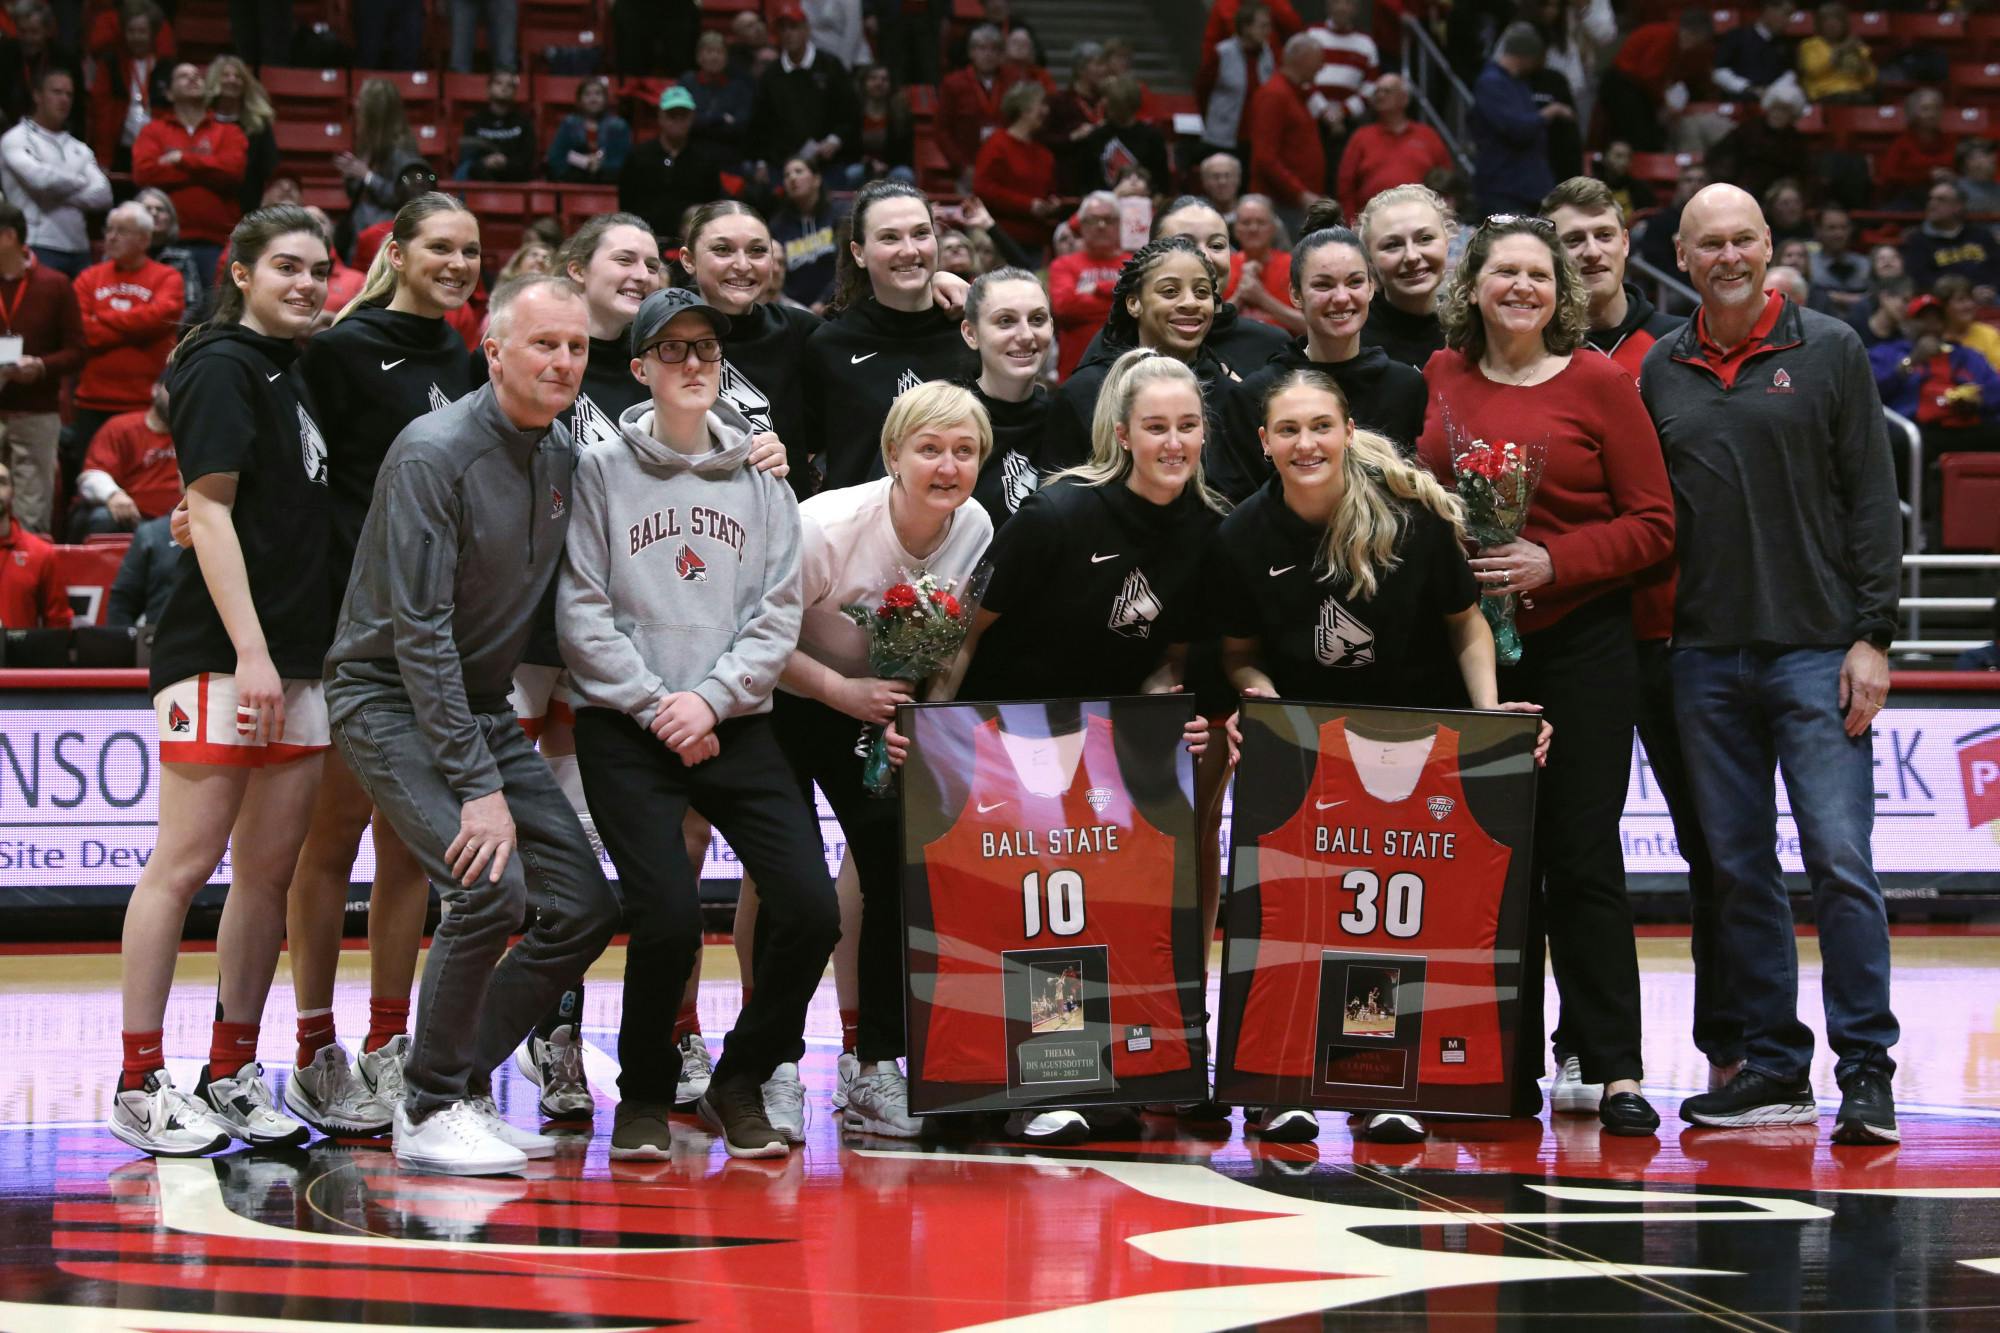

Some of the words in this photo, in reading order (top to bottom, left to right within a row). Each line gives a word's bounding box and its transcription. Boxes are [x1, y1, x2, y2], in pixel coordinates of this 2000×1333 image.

[629, 506, 682, 558] BALL
[690, 506, 747, 566] STATE
[982, 830, 1039, 858] BALL
[1049, 824, 1119, 855] STATE
[1315, 825, 1373, 854] BALL
[1383, 829, 1457, 859] STATE
[1022, 869, 1087, 939] 10
[1339, 868, 1425, 939] 30
[1133, 1027, 1143, 1037] M
[1448, 1040, 1458, 1049] M
[1044, 1048, 1076, 1058] THELMA
